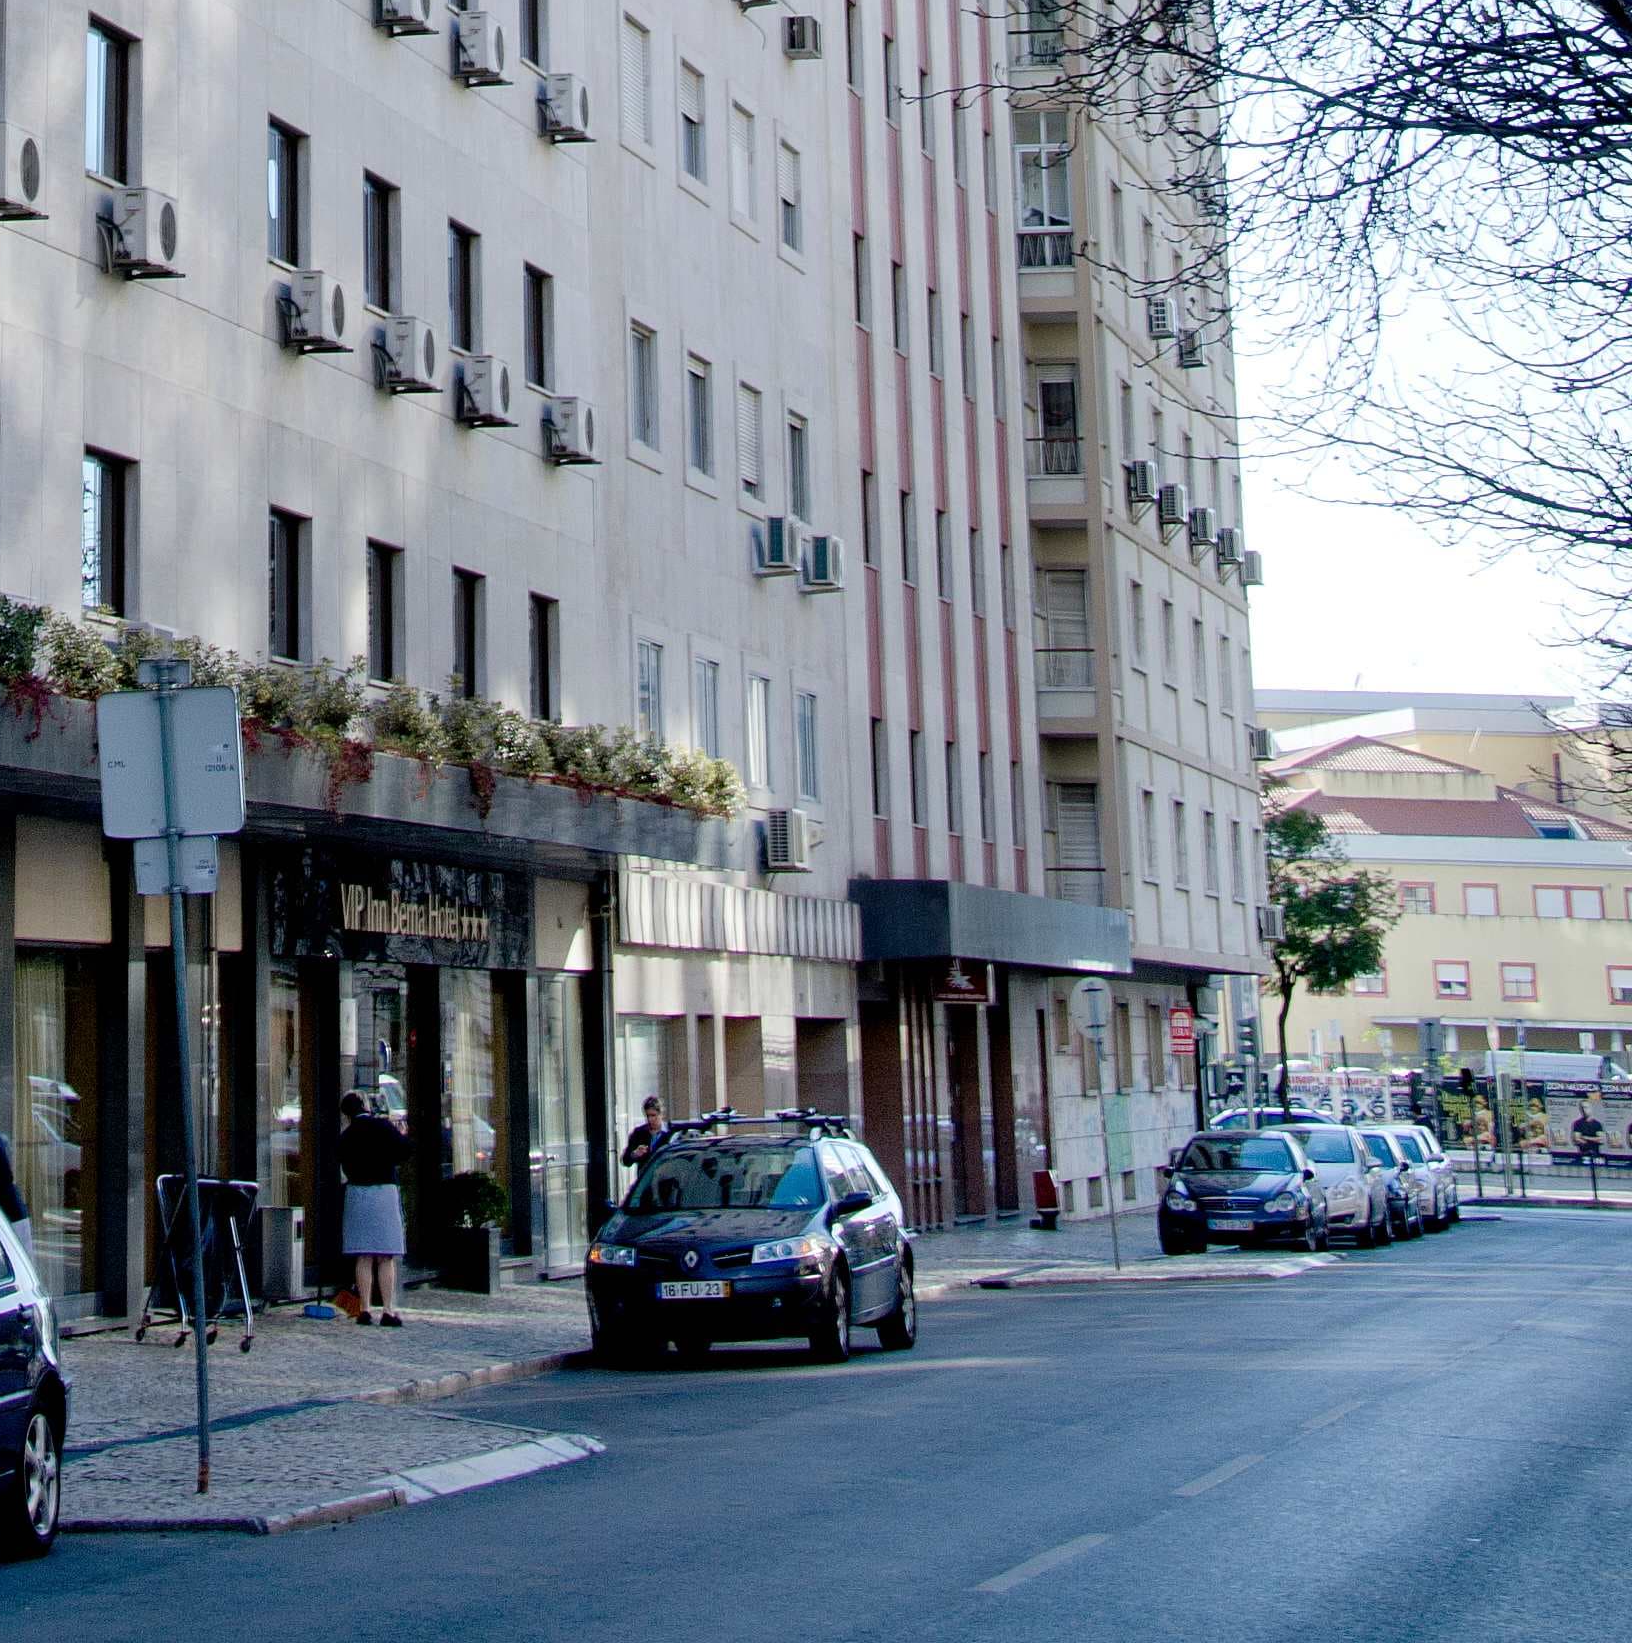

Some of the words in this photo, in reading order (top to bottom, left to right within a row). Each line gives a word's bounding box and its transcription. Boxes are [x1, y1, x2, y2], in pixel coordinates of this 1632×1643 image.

[341, 883, 365, 931] VIP
[367, 886, 388, 934] Inn
[391, 889, 428, 937] Berna
[429, 893, 460, 940] Hotel
